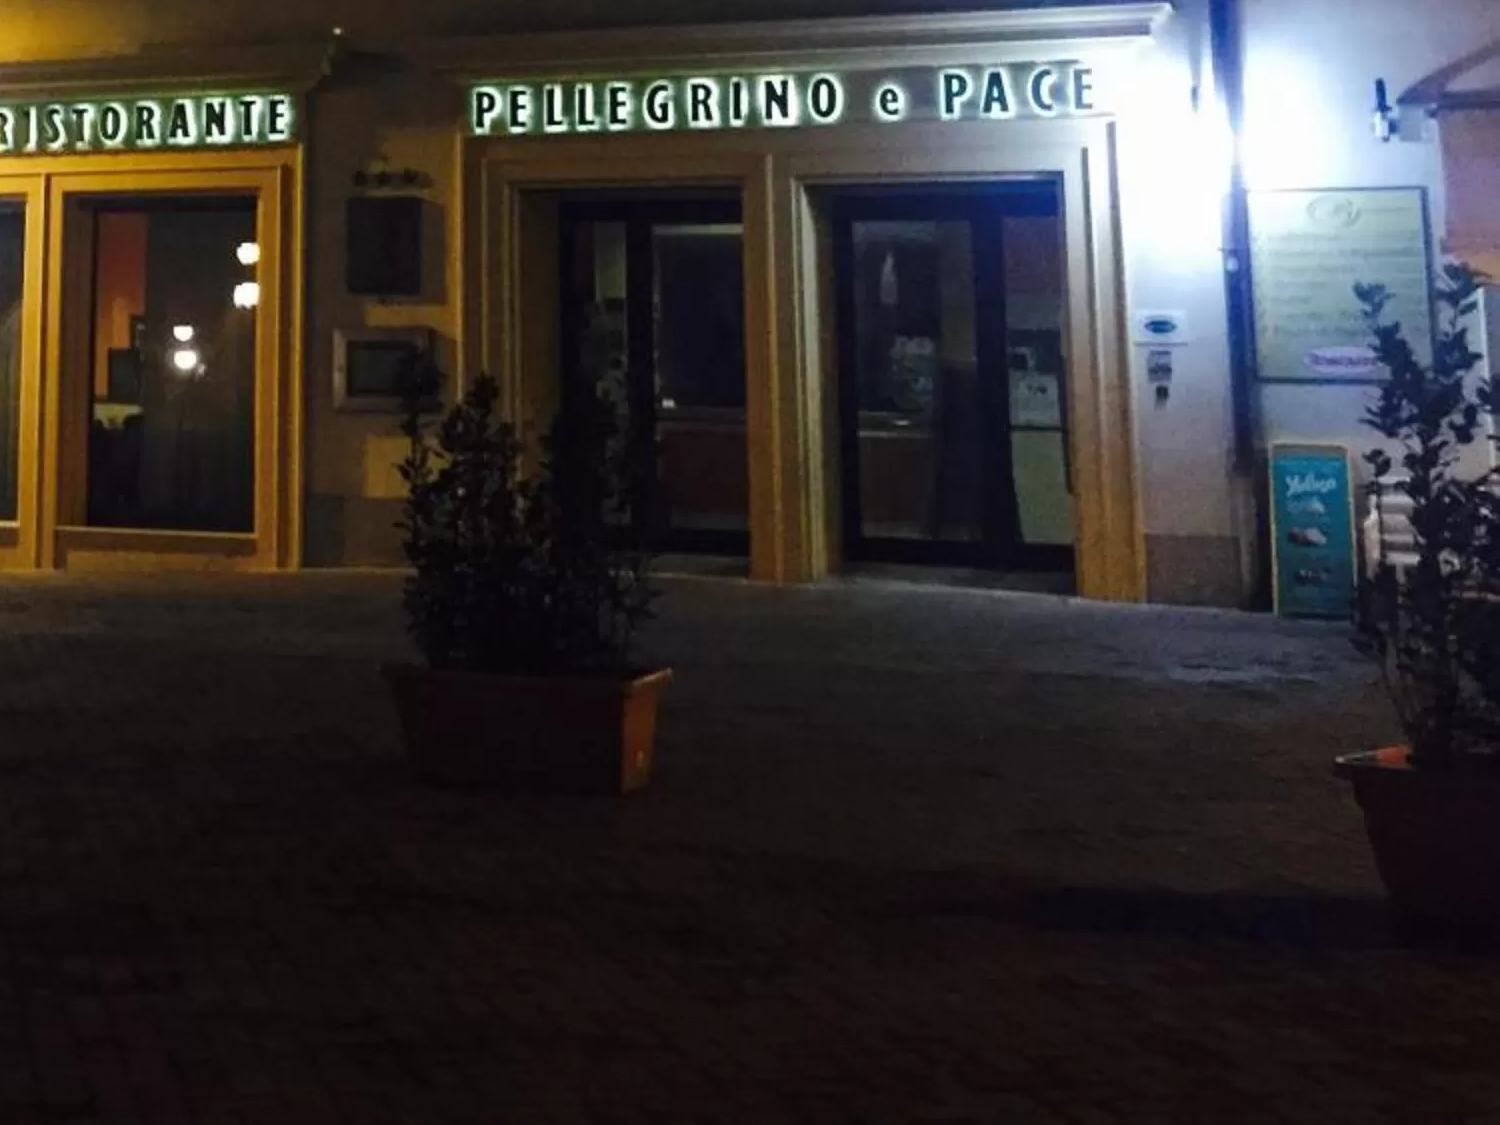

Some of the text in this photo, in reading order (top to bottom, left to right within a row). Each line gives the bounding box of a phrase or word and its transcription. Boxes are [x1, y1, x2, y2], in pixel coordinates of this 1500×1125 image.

[474, 67, 1094, 128] PELLEGRINO e PACE
